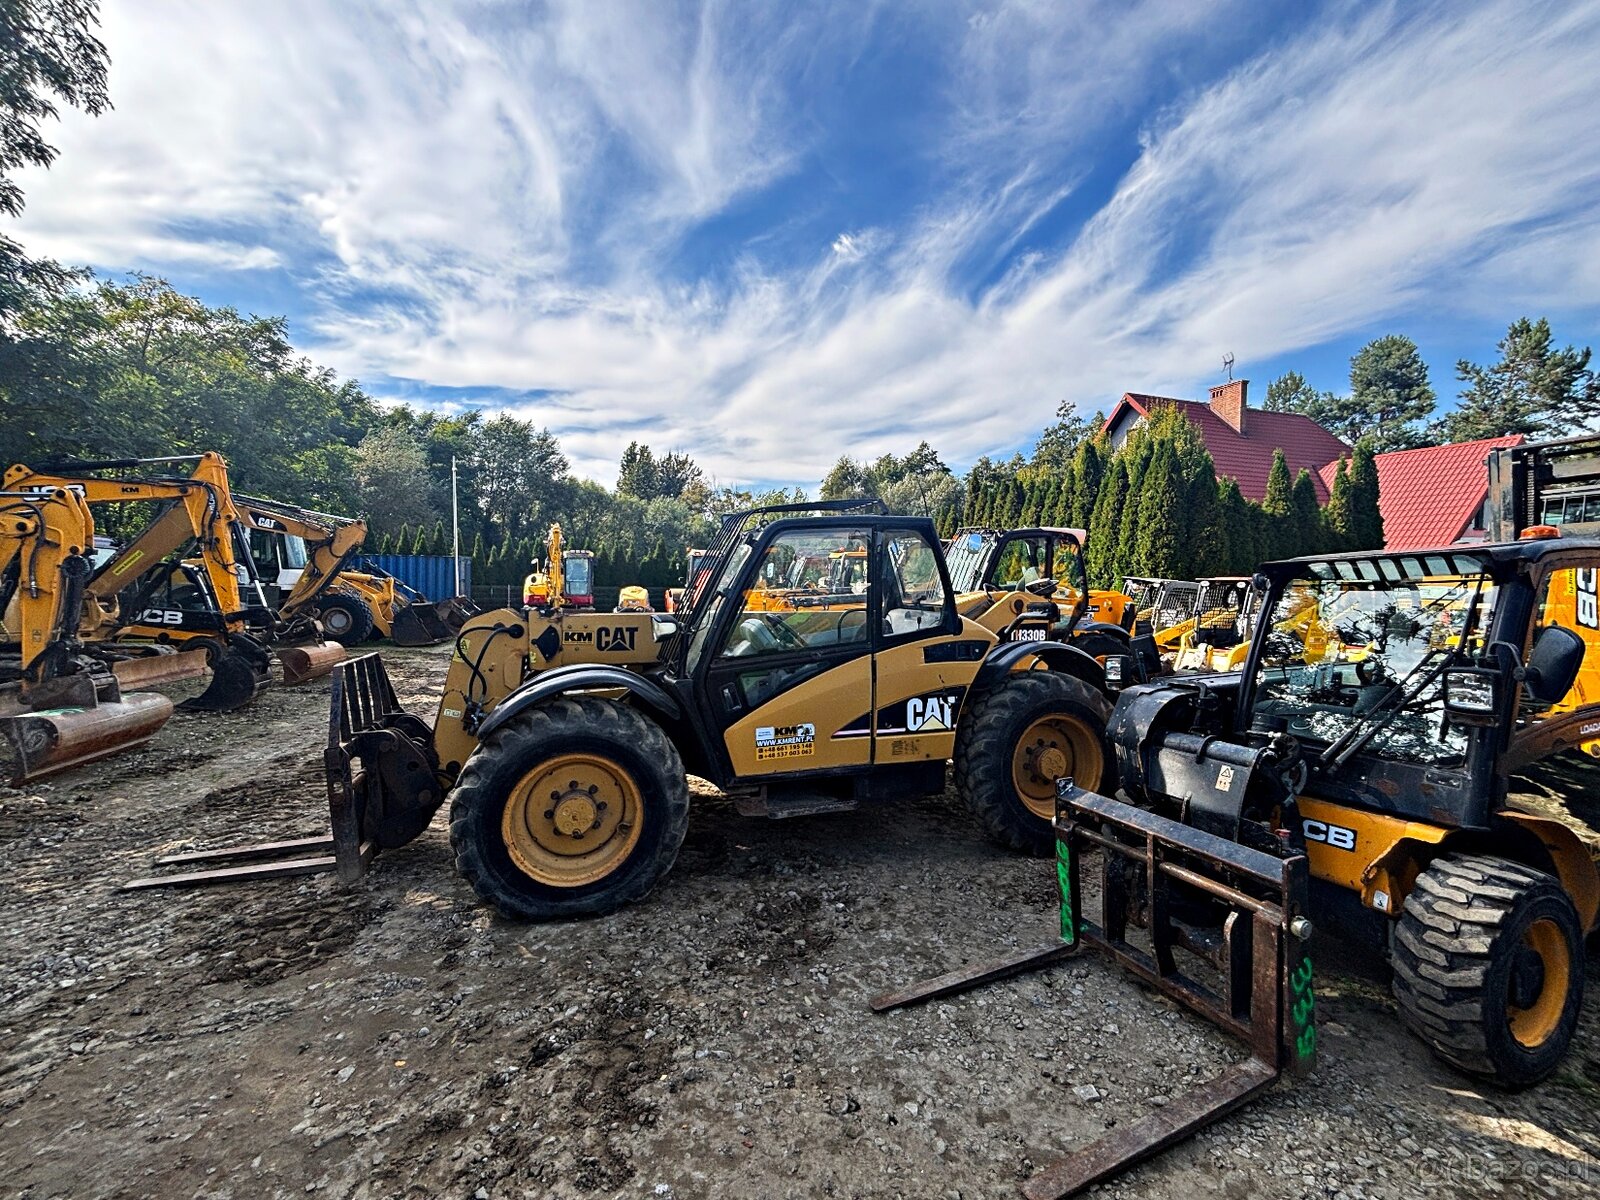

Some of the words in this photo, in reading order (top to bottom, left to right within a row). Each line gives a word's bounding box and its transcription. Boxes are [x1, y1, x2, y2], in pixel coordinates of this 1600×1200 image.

[258, 517, 276, 528] CAT
[1576, 567, 1597, 628] CB
[564, 632, 593, 642] KM
[596, 626, 639, 651] CAT
[906, 696, 958, 732] CAT
[774, 726, 798, 736] KM
[1302, 819, 1355, 849] CB
